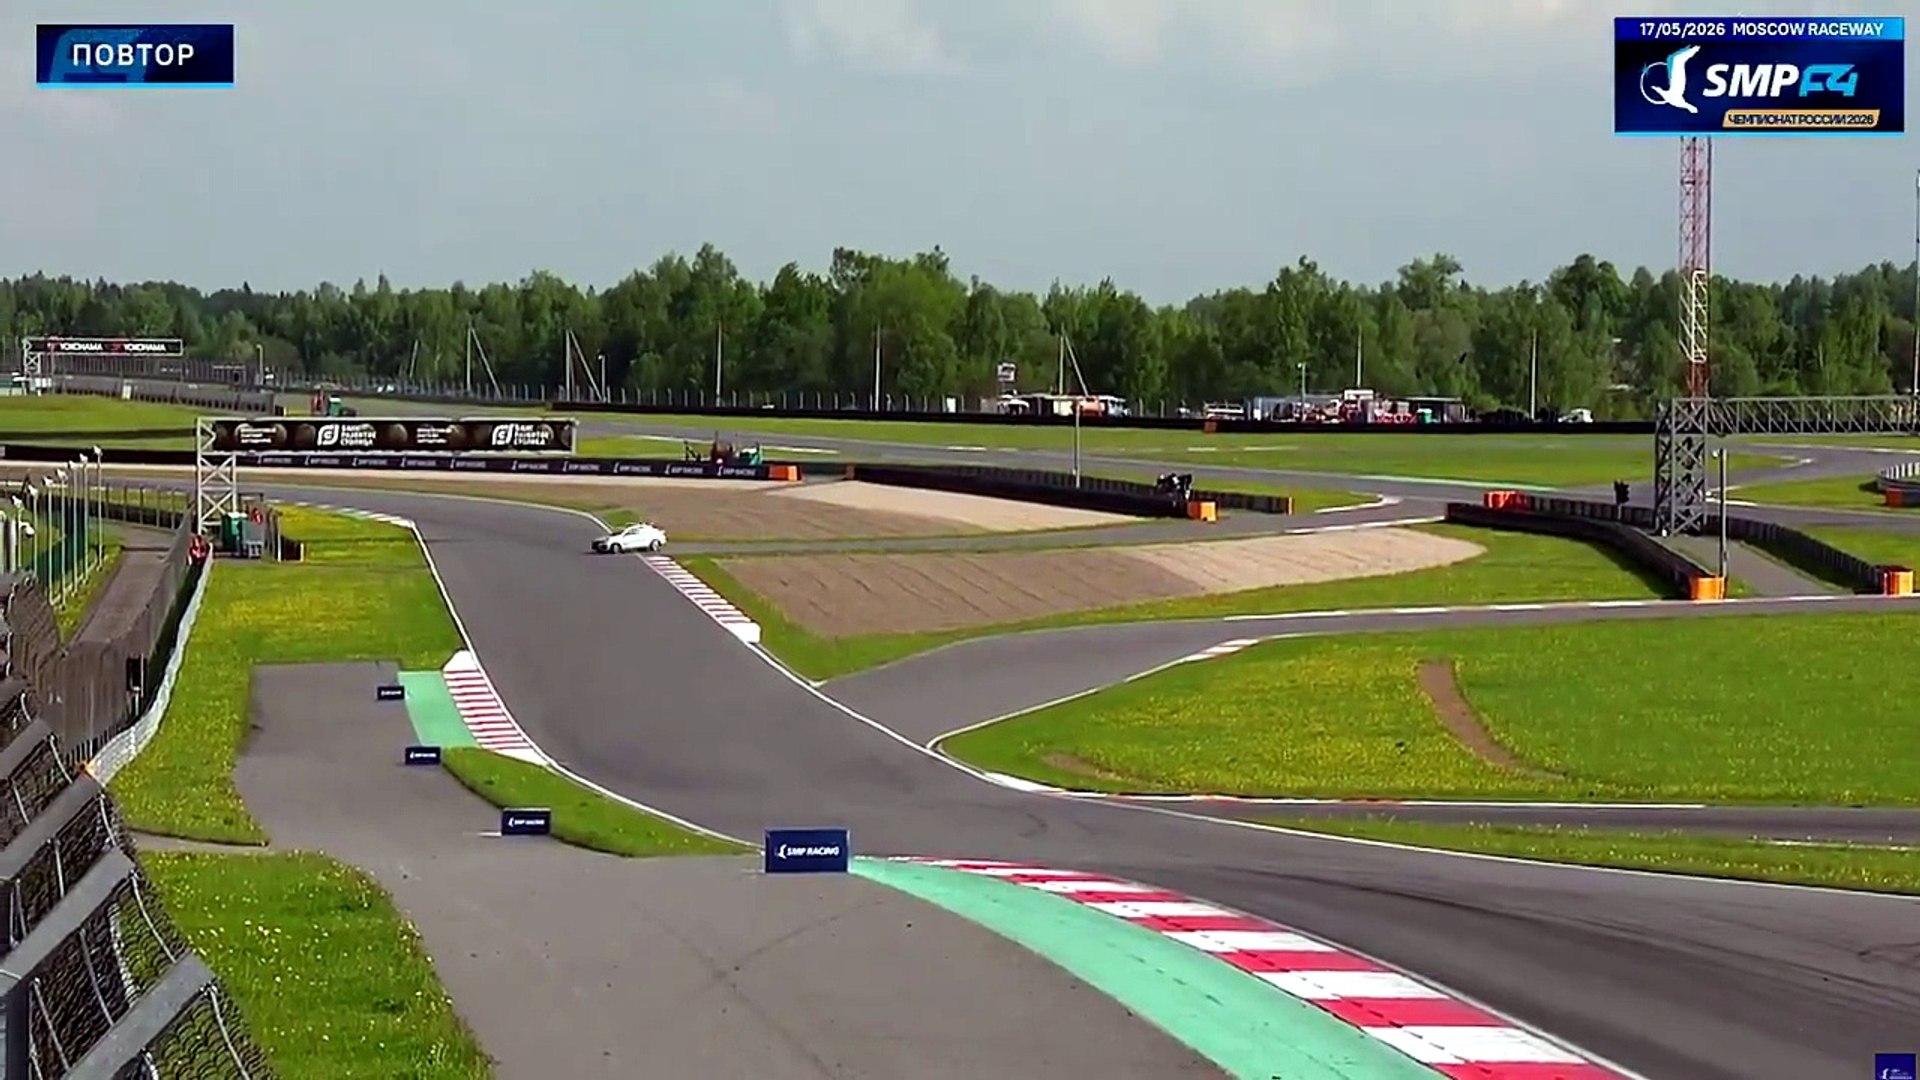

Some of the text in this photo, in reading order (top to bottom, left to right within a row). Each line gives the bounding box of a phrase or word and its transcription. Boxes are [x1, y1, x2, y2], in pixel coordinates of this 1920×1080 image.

[60, 343, 167, 351] YOKOHAMA YOKOHAMA
[787, 846, 840, 856] SMP RACING
